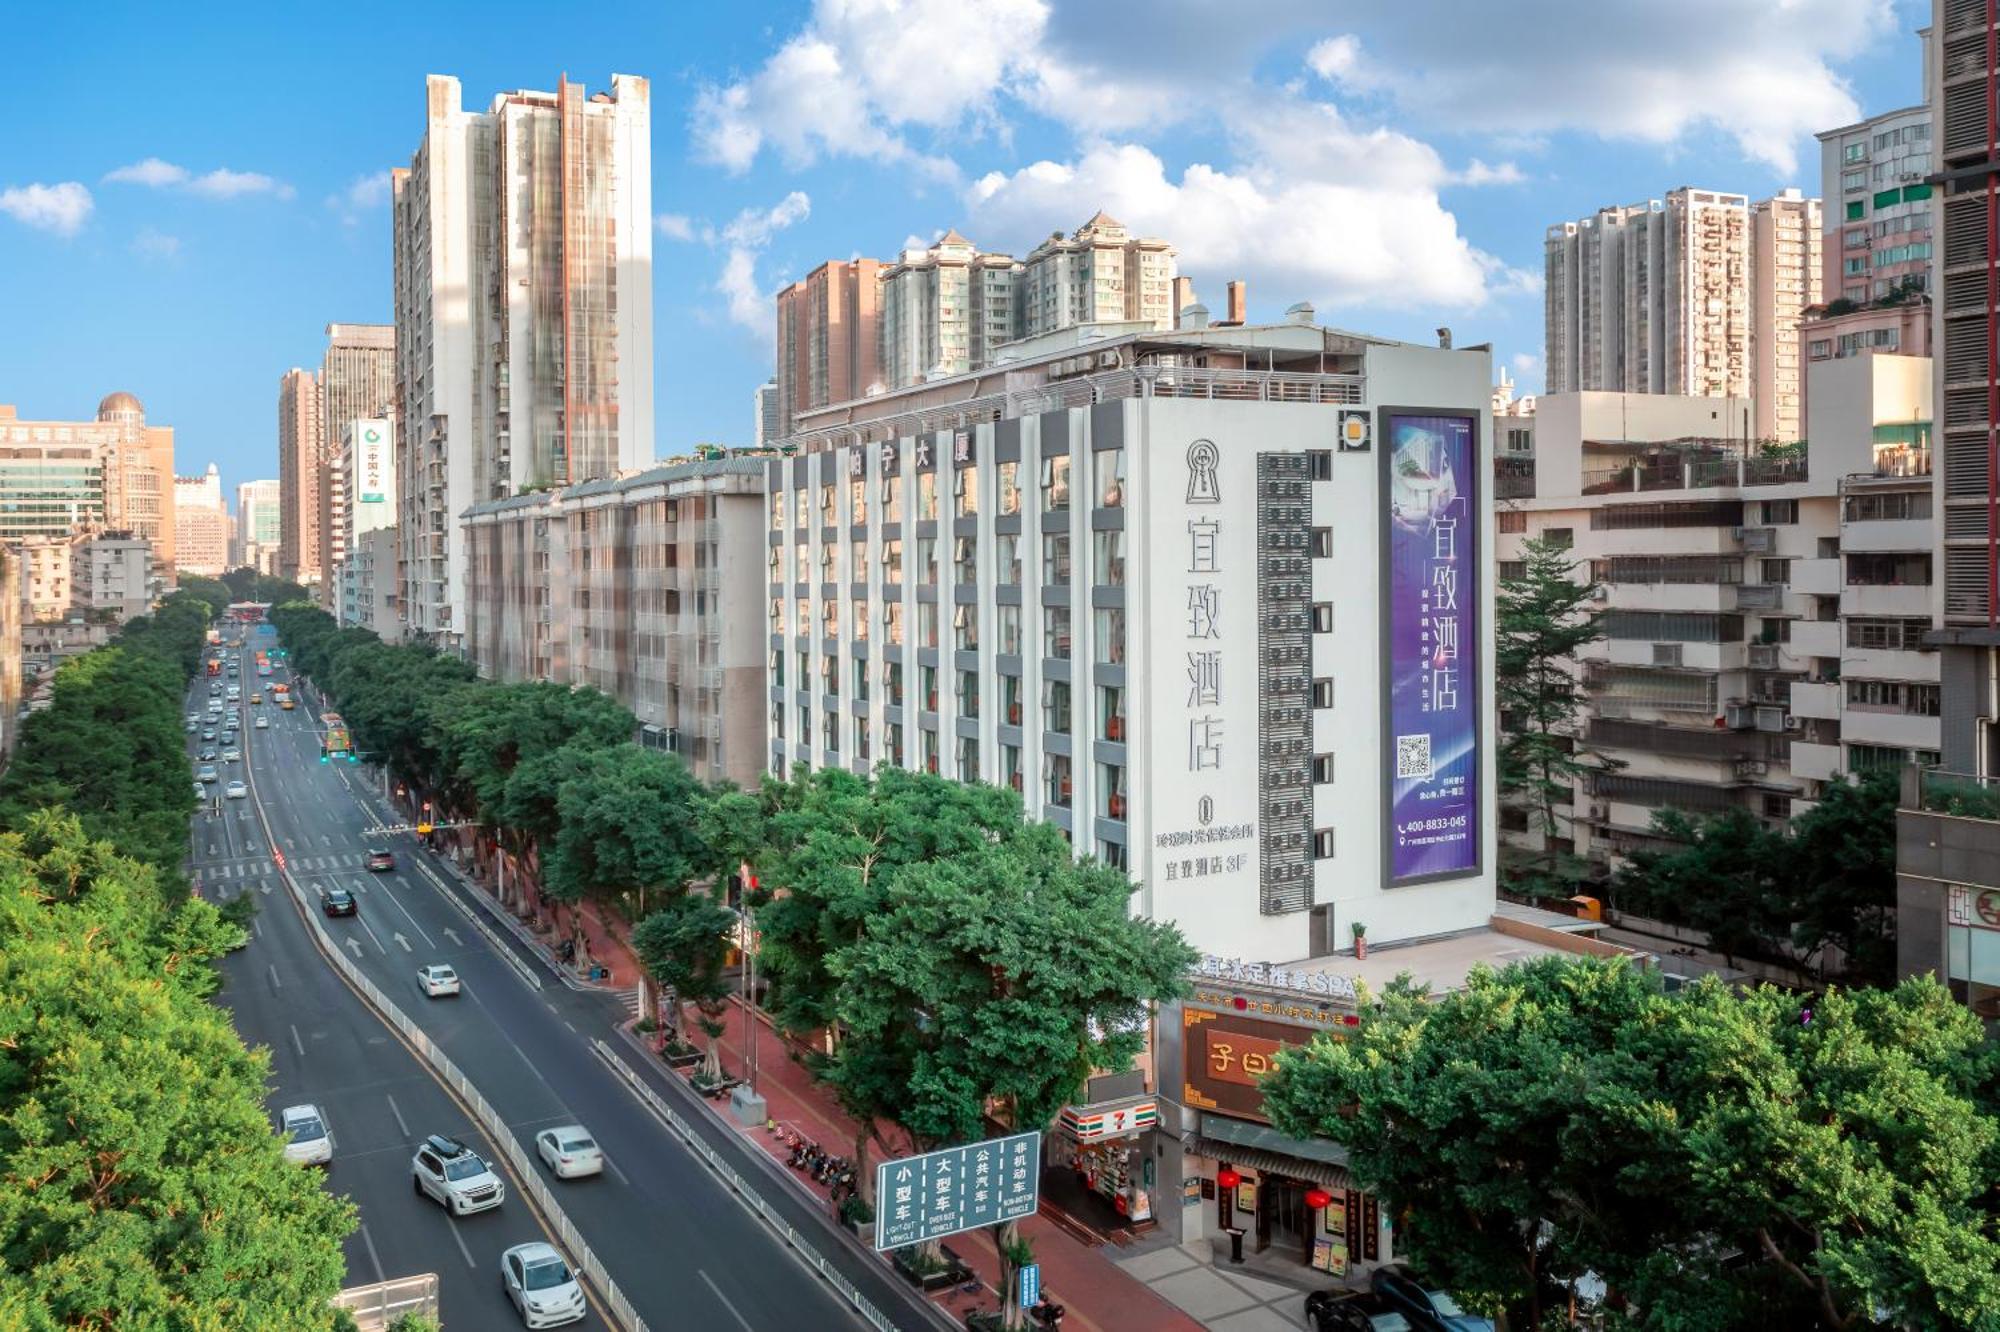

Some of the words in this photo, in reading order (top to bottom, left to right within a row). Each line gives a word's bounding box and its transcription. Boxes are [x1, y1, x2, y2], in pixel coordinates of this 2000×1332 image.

[367, 452, 379, 488] 中国人寿
[1432, 514, 1458, 712] 宜致酒店
[1187, 515, 1223, 773] 宜致酒店
[1406, 815, 1467, 833] 400-8833-045
[895, 1165, 912, 1221] 小型车
[935, 1158, 951, 1212] 大型车
[975, 1149, 990, 1202] 公共汽车
[1013, 1142, 1028, 1193] 非机动车
